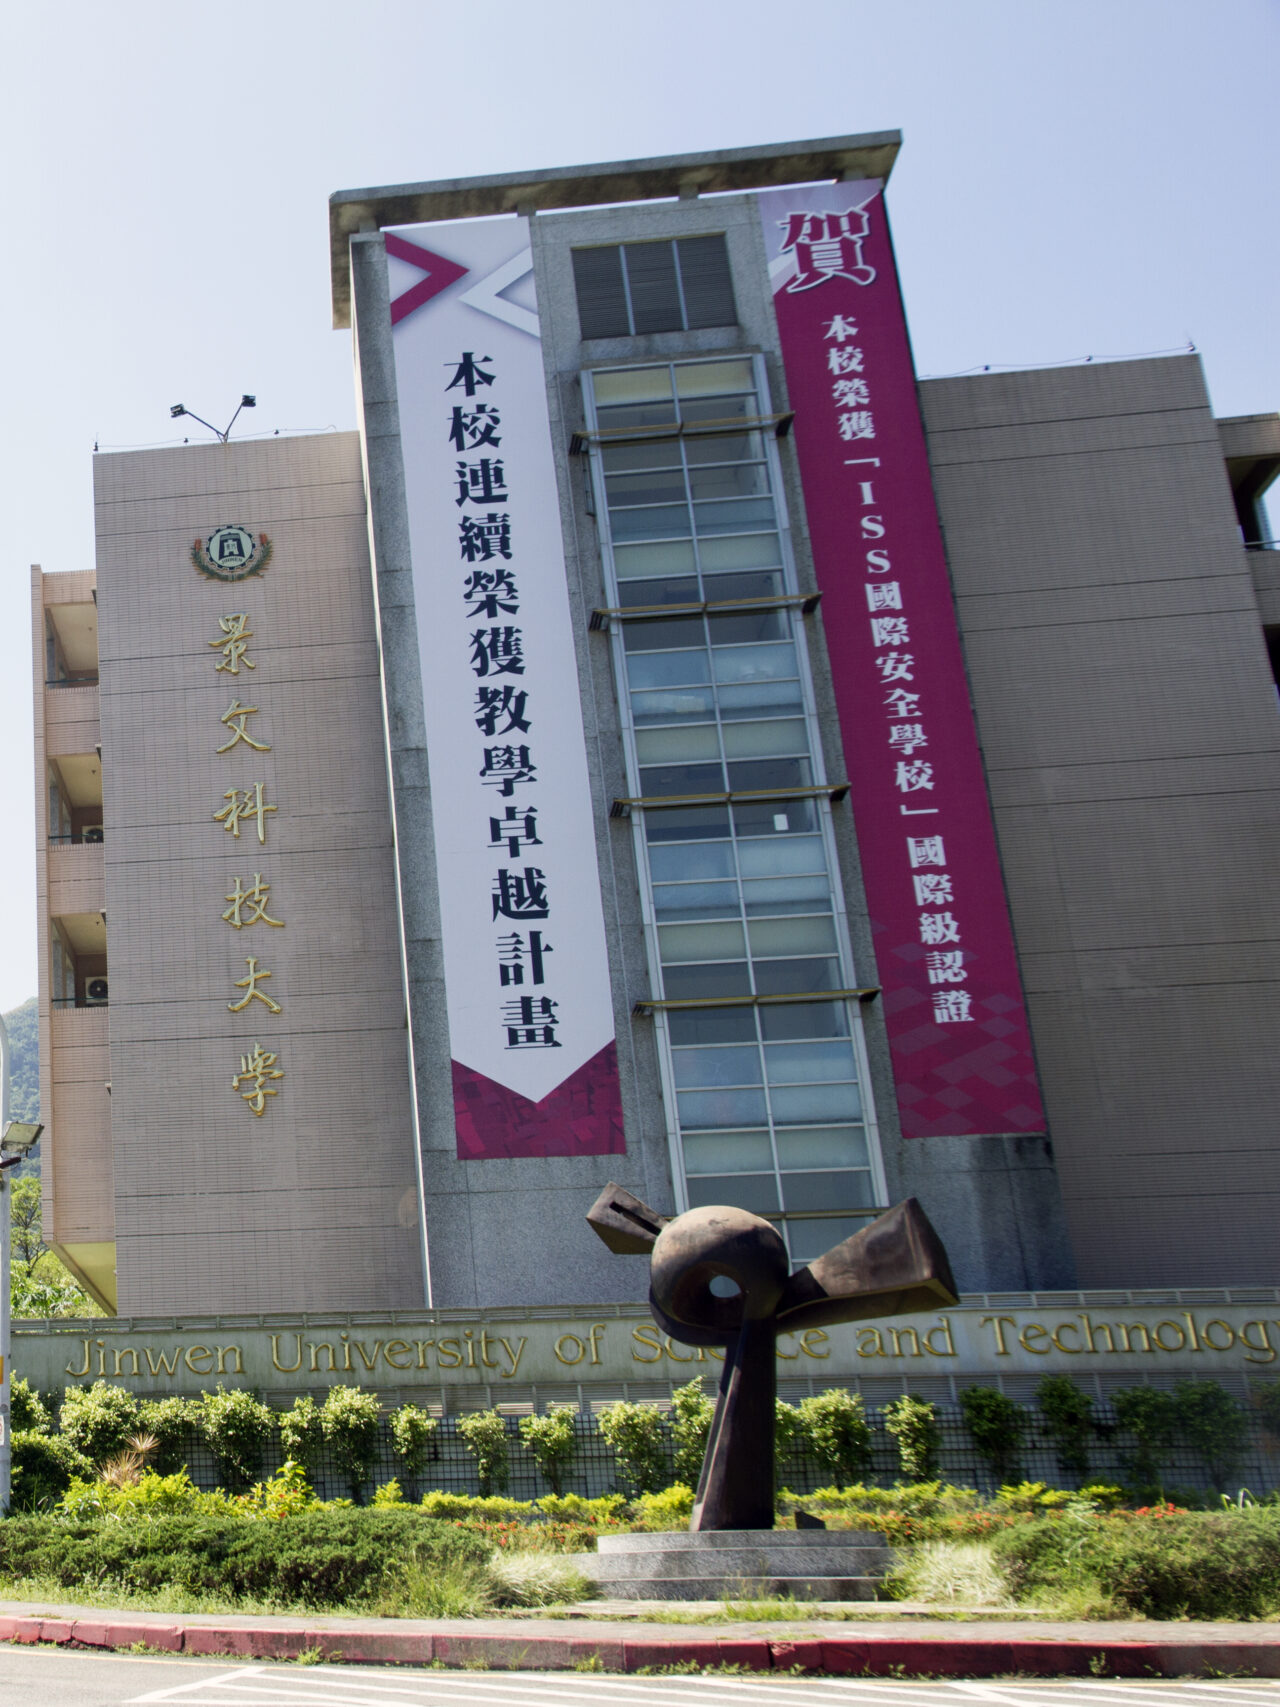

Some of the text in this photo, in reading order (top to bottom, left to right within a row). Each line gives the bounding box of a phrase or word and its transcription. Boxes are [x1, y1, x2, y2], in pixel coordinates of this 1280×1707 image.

[775, 205, 877, 295] 賀
[443, 351, 563, 1050] 本校連續榮獲教學卓越計畫
[821, 313, 976, 1026] 本校榮獲「ISS國際安全學校」國際級認證
[64, 1311, 1280, 1378] Jinwen University of Scce and Technolog
